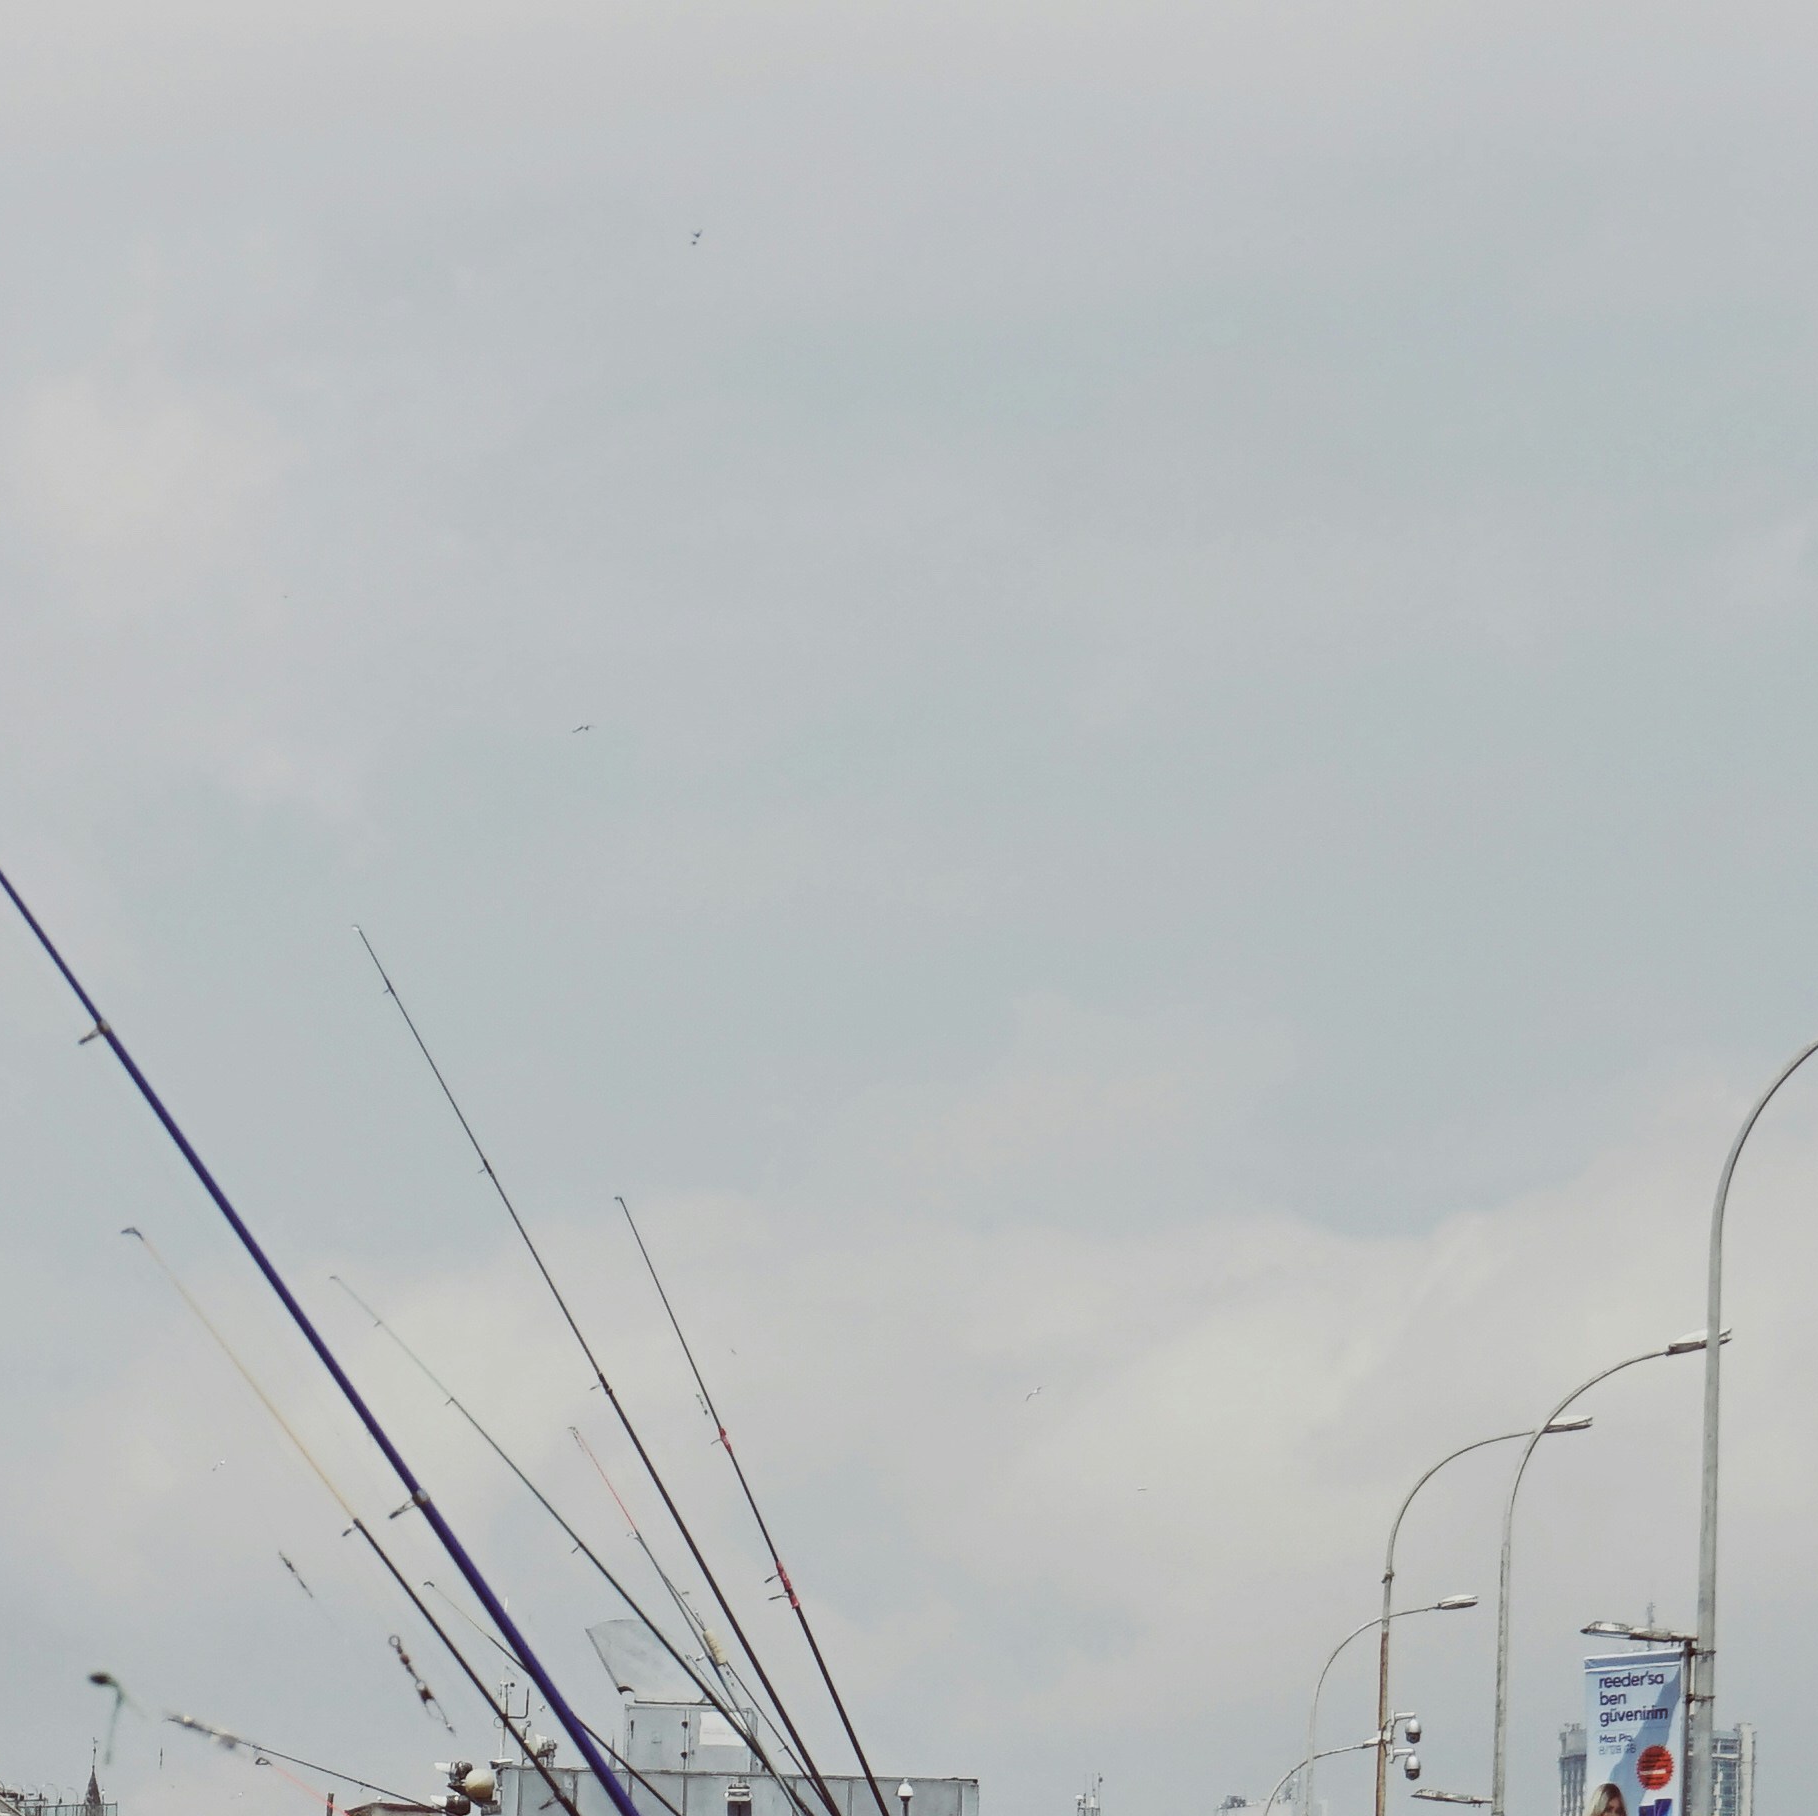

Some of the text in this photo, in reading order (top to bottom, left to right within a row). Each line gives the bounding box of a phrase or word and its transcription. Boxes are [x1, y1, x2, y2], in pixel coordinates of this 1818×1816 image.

[1599, 1671, 1665, 1689] reeder'sa
[1599, 1691, 1627, 1706] ben
[1599, 1705, 1668, 1727] güvenirim
[1599, 1733, 1633, 1743] Max Pro
